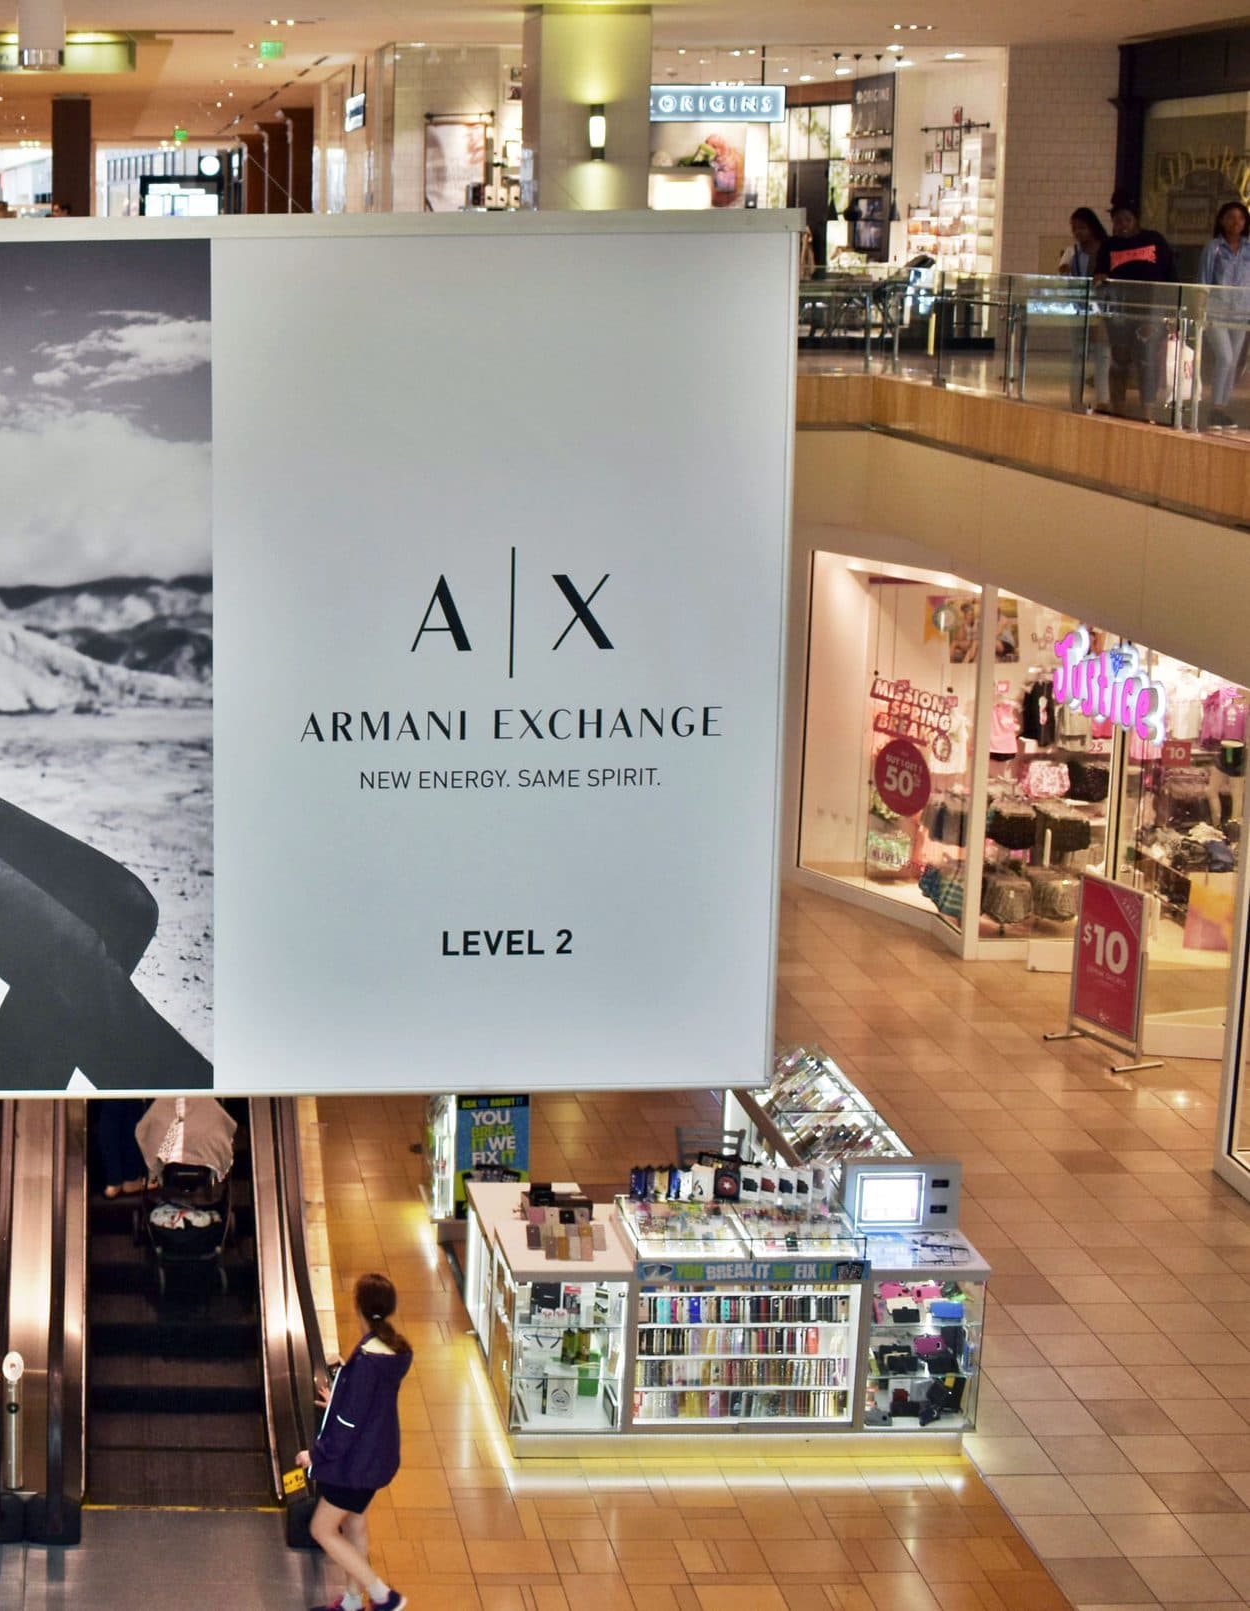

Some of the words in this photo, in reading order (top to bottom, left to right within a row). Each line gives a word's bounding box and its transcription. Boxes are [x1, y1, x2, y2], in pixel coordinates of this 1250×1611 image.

[658, 95, 774, 113] ORIGINS
[1053, 630, 1155, 742] Justice
[300, 710, 467, 743] ARMANI
[493, 706, 724, 740] EXCHANGE
[888, 700, 951, 731] SPRING
[360, 771, 411, 790] NEW
[418, 770, 511, 789] ENERGY.
[518, 769, 580, 788] SAME
[587, 767, 662, 787] SPIRIT.
[442, 930, 545, 956] LEVEL
[555, 929, 573, 955] 2
[1083, 921, 1129, 975] $10
[471, 1110, 511, 1125] YOU
[471, 1124, 514, 1138] BREAK
[471, 1138, 486, 1151] IT
[488, 1136, 516, 1150] WE
[472, 1151, 499, 1165] FIX
[501, 1150, 514, 1163] IT
[676, 1264, 704, 1279] YOU
[706, 1264, 754, 1279] BREAK
[755, 1264, 770, 1278] IT
[794, 1264, 817, 1278] FIX
[818, 1264, 833, 1278] IT
